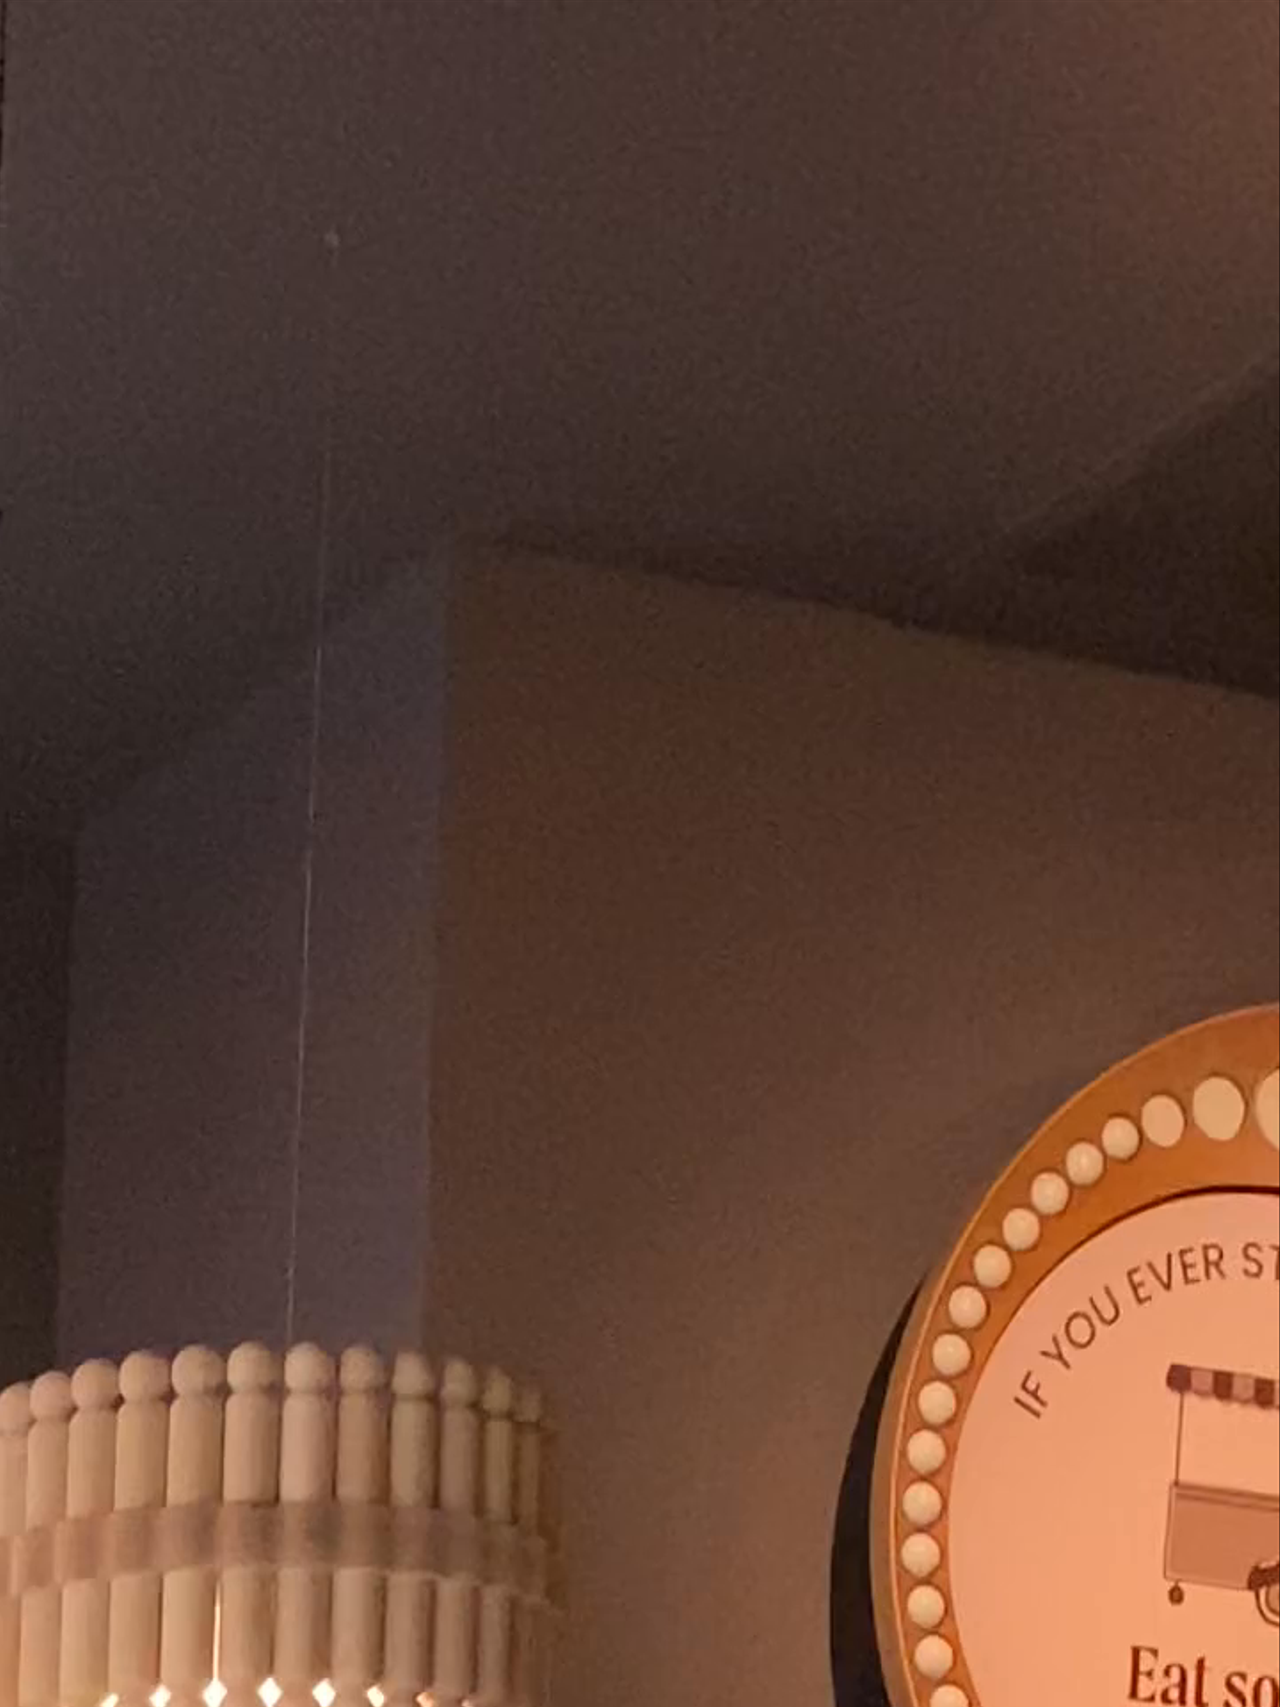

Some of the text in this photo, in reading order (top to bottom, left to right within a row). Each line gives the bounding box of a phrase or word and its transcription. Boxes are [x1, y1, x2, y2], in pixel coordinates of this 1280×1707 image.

[1013, 1370, 1048, 1420] IF
[1040, 1284, 1122, 1370] YOU
[1126, 1243, 1226, 1306] EVER
